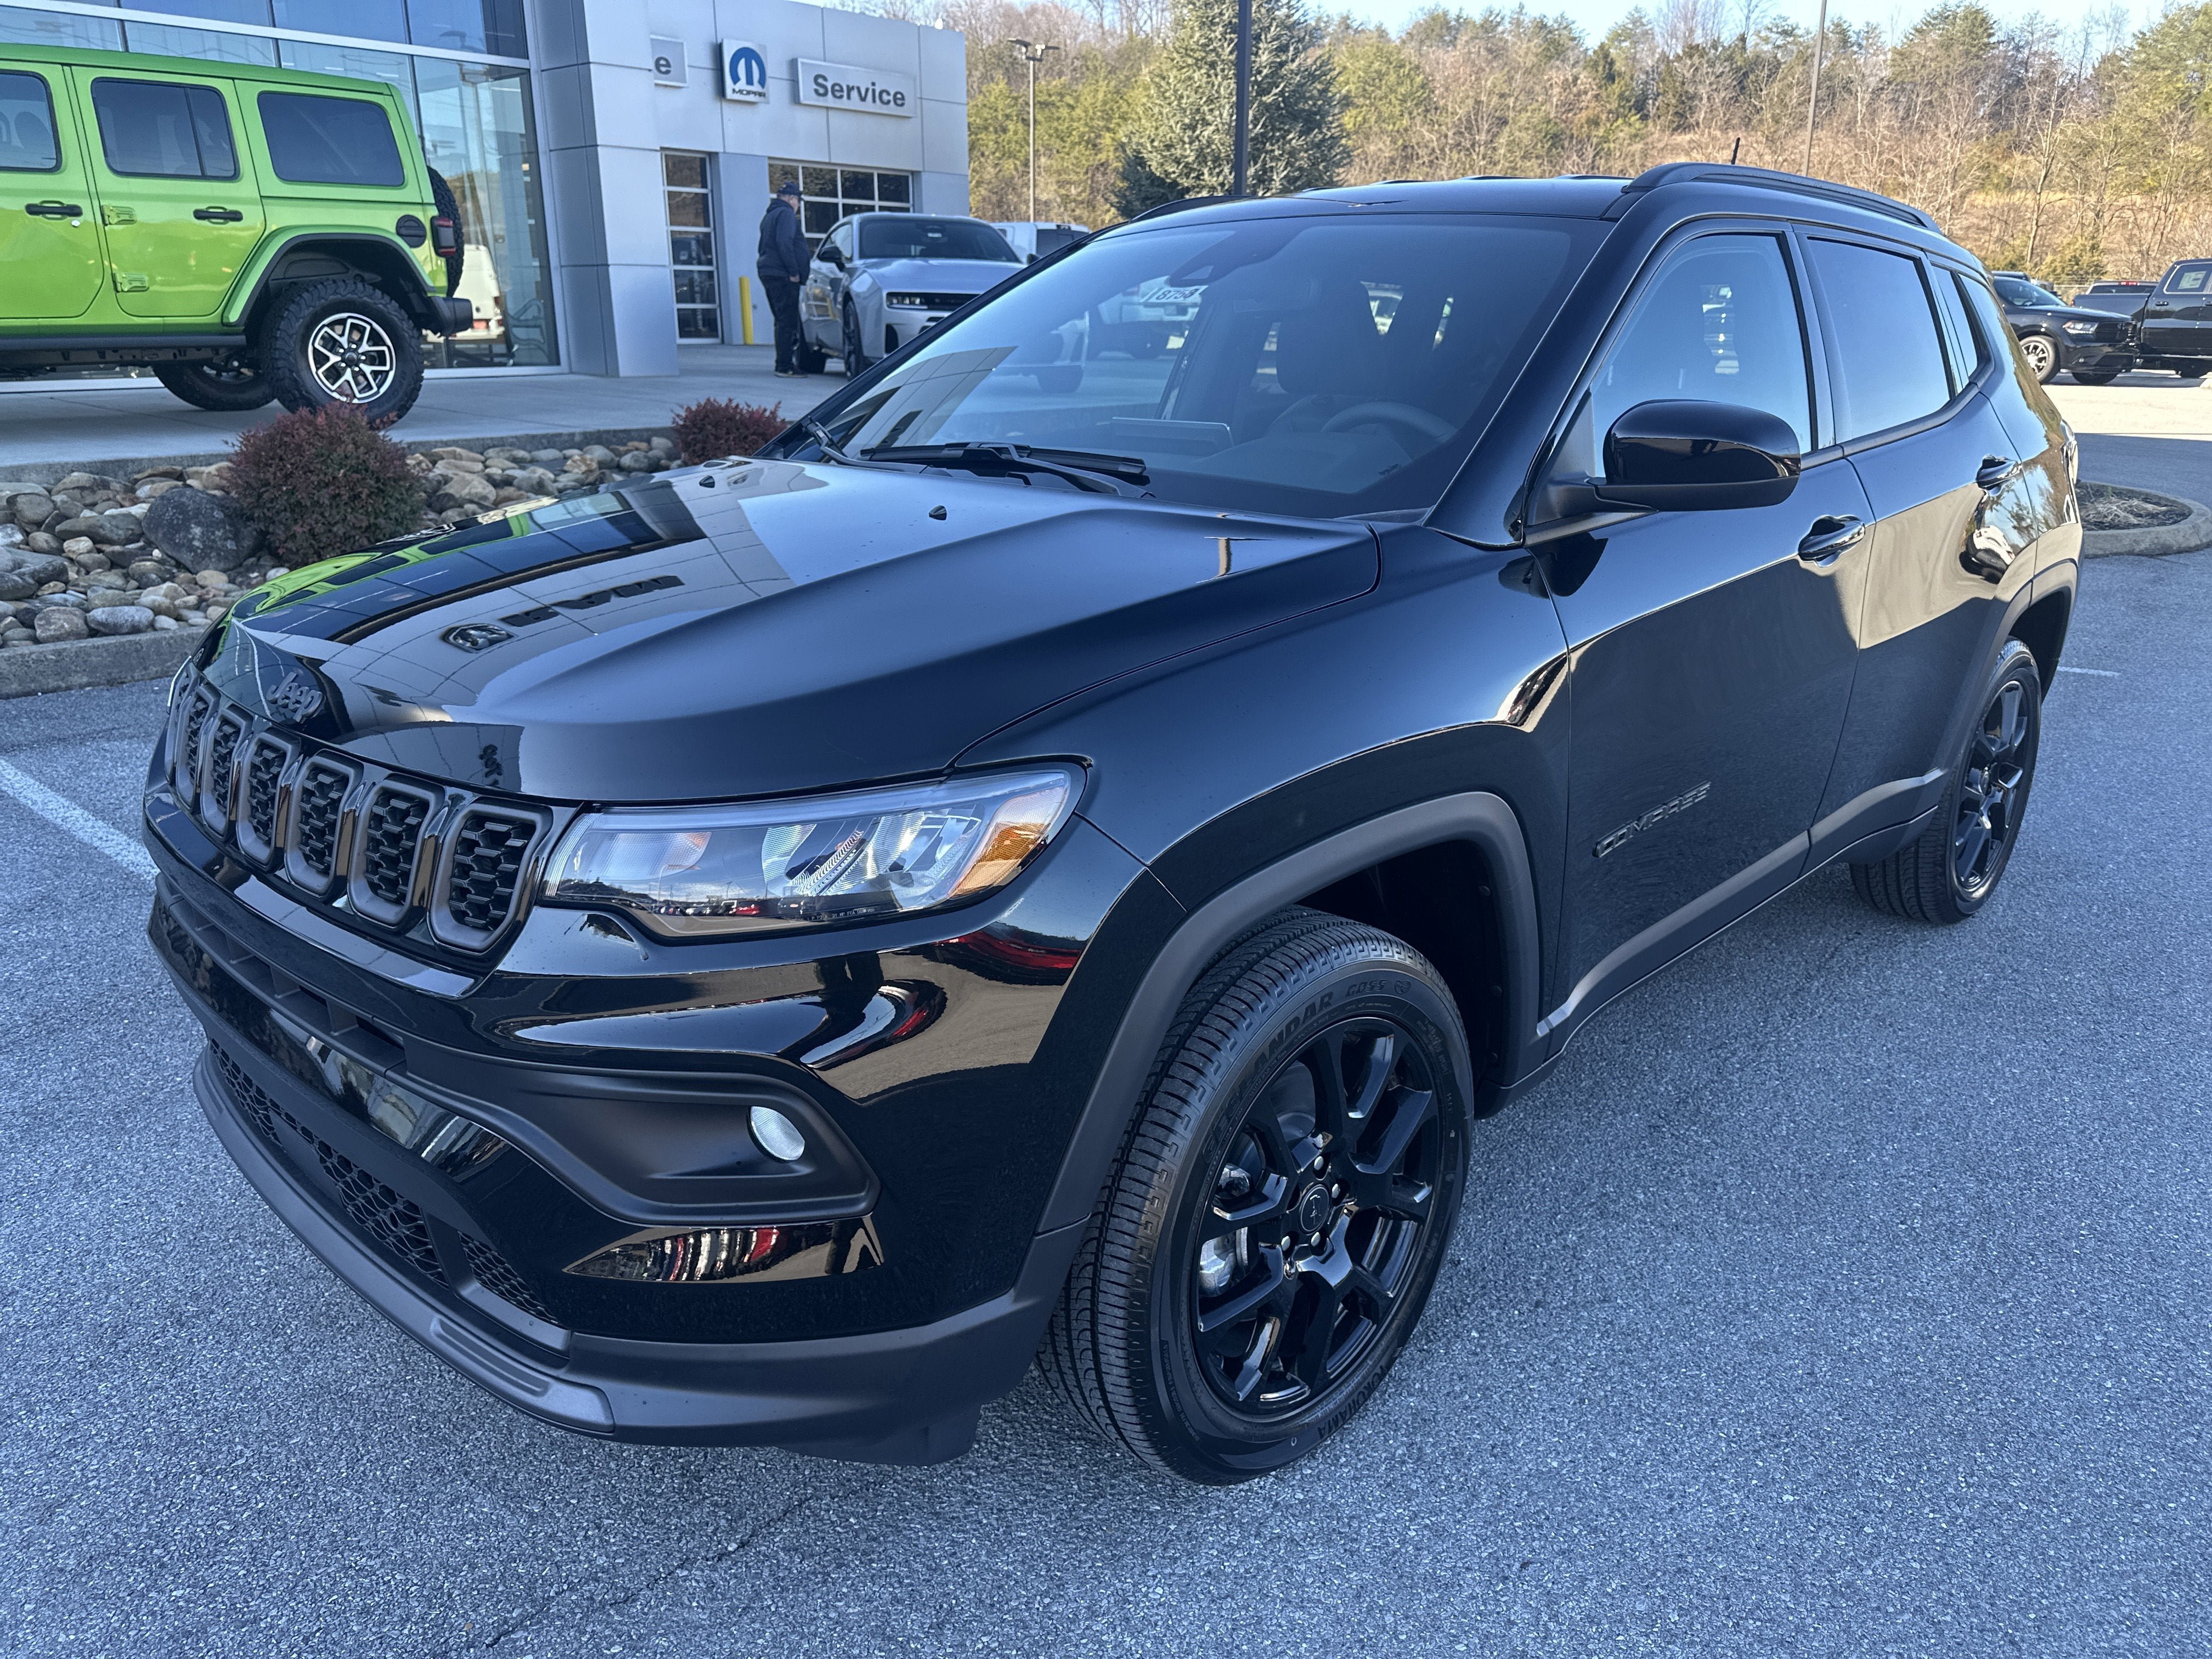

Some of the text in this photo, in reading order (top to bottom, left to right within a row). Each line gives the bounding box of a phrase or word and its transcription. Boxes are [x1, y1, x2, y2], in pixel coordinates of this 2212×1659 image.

[732, 88, 766, 98] MOPAR
[813, 74, 906, 108] Service
[266, 671, 324, 723] Jeep
[1593, 781, 1712, 858] COMPASS
[1317, 1364, 1387, 1439] YOKOHAMA
